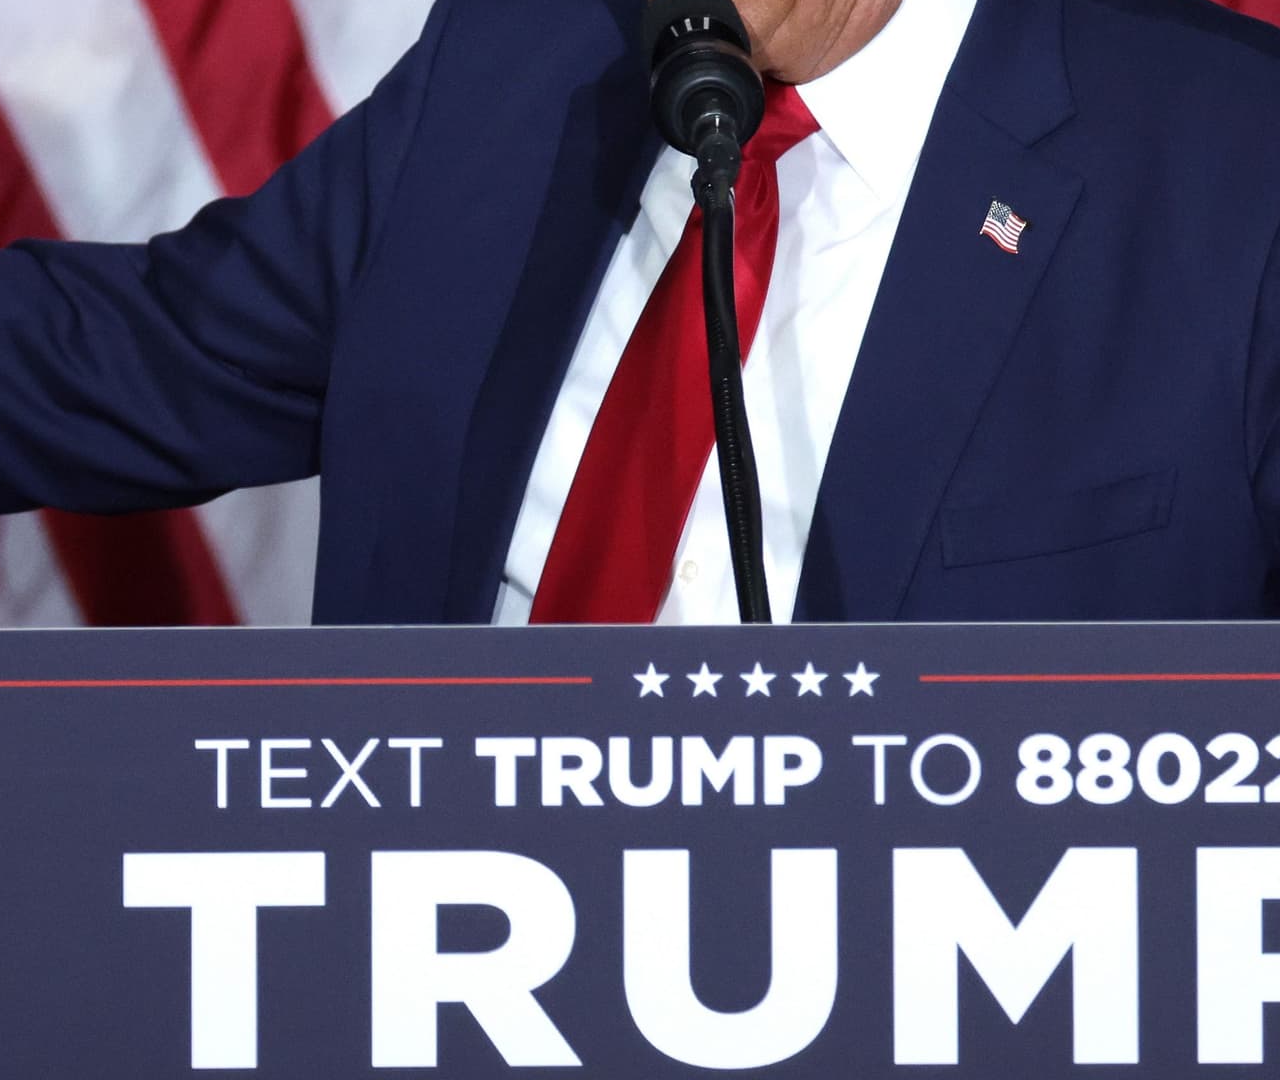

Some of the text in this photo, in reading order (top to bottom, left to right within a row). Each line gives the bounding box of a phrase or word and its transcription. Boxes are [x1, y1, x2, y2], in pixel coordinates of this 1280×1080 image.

[194, 737, 444, 809] TEXT
[474, 735, 823, 808] TRUMP
[851, 733, 982, 806] TO
